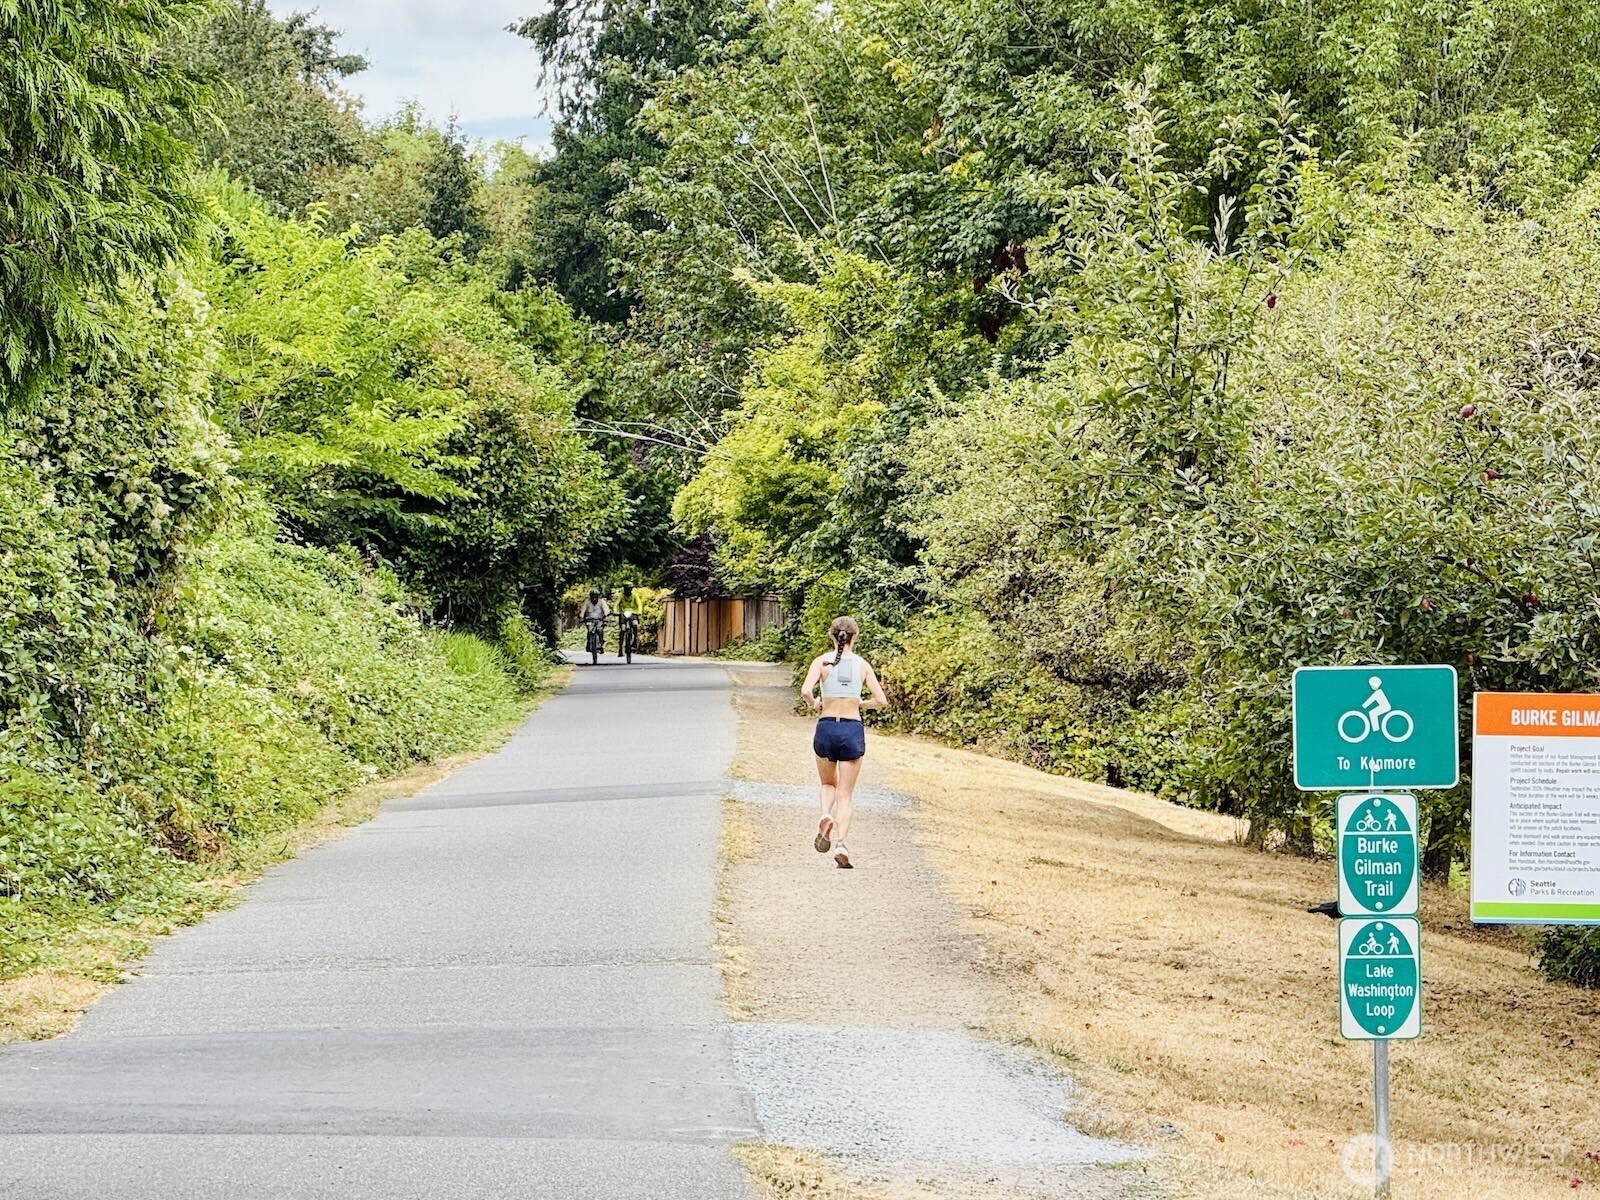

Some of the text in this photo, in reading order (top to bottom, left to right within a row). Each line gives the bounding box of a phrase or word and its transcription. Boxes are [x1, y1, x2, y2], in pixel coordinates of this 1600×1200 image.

[1510, 709, 1558, 726] BURKE
[1510, 745, 1531, 753] Project
[1337, 756, 1350, 771] To
[1510, 777, 1530, 785] Project
[1357, 837, 1398, 854] Burke
[1354, 858, 1402, 875] Gilman
[1364, 880, 1394, 896] Trail
[1366, 963, 1394, 978] Lake
[1347, 983, 1413, 1001] Washington
[1366, 1002, 1395, 1019] Loop
